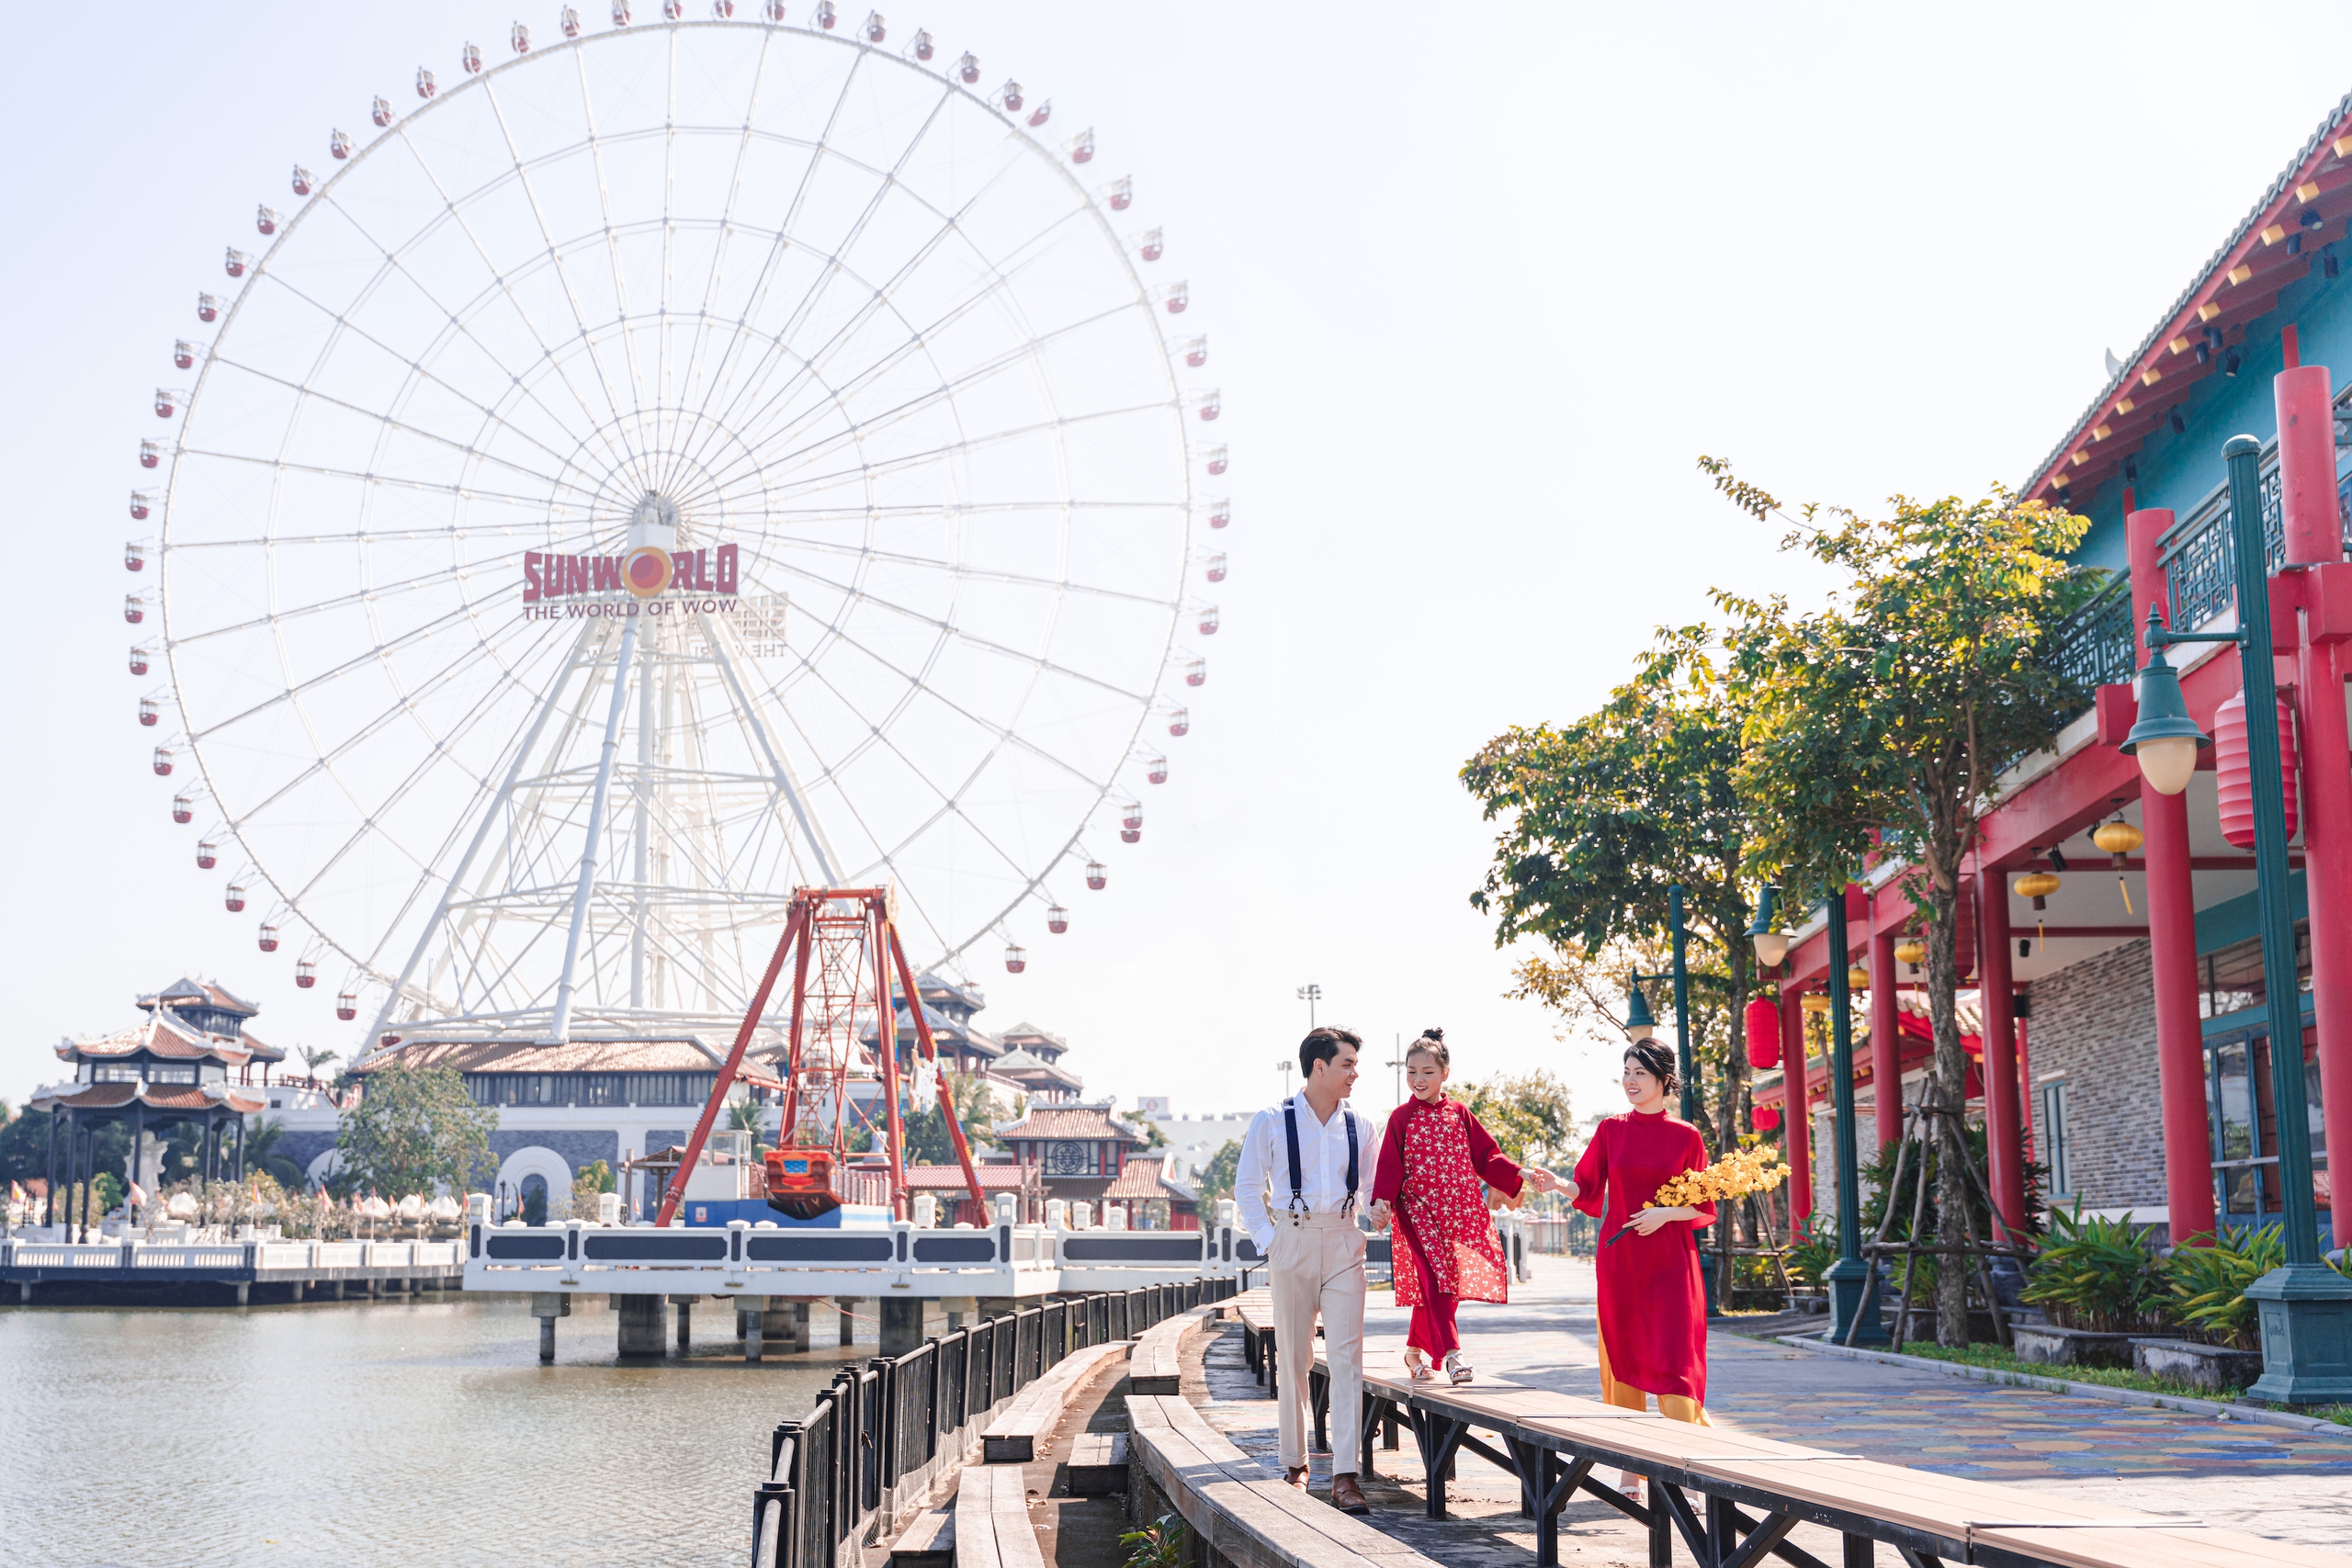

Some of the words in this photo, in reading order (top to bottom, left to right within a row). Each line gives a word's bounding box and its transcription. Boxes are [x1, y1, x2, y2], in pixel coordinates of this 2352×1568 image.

[523, 606, 560, 620] THE
[567, 603, 639, 618] WORLD
[648, 601, 675, 615] OF
[682, 599, 737, 614] WOW
